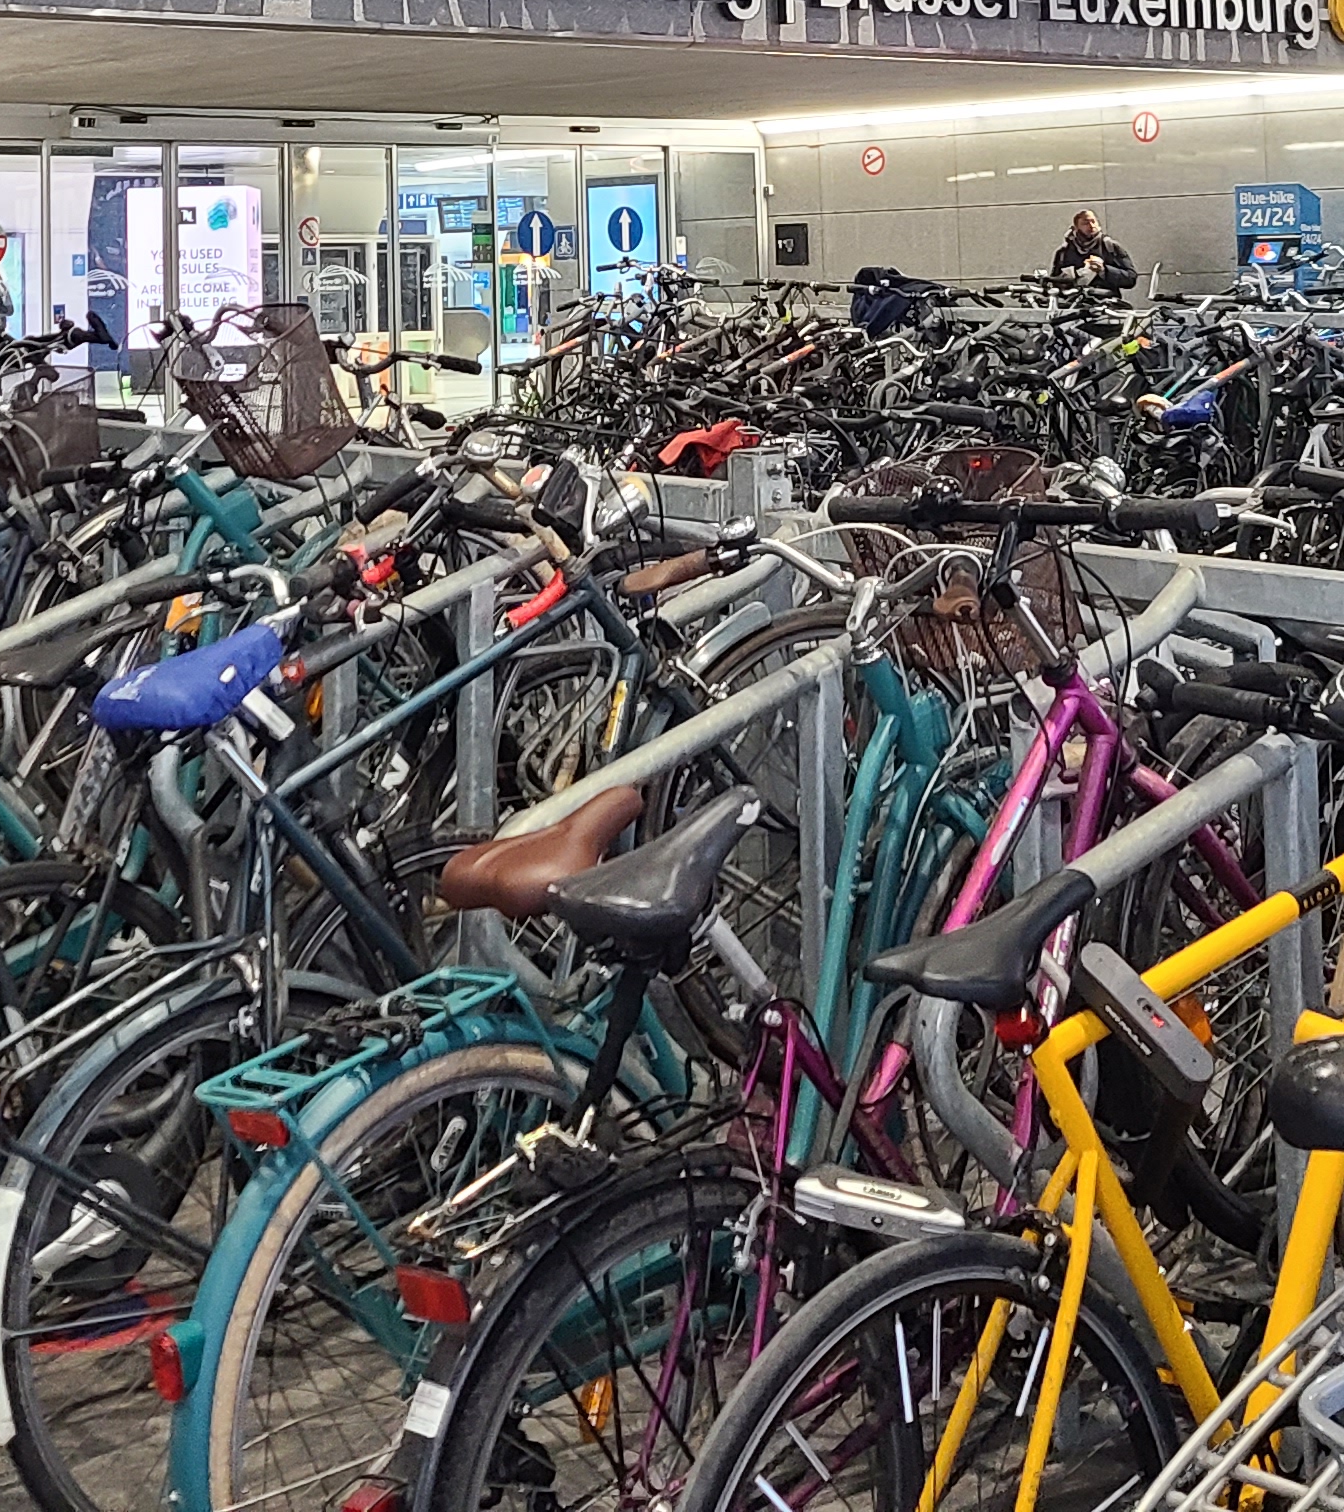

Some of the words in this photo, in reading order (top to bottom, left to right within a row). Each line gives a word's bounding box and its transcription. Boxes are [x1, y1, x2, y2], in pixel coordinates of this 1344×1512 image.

[1239, 190, 1296, 205] Blue-bike
[1239, 207, 1296, 227] 24/24
[190, 248, 223, 260] USED
[154, 263, 220, 275] CSULES
[179, 282, 231, 295] ELCOME
